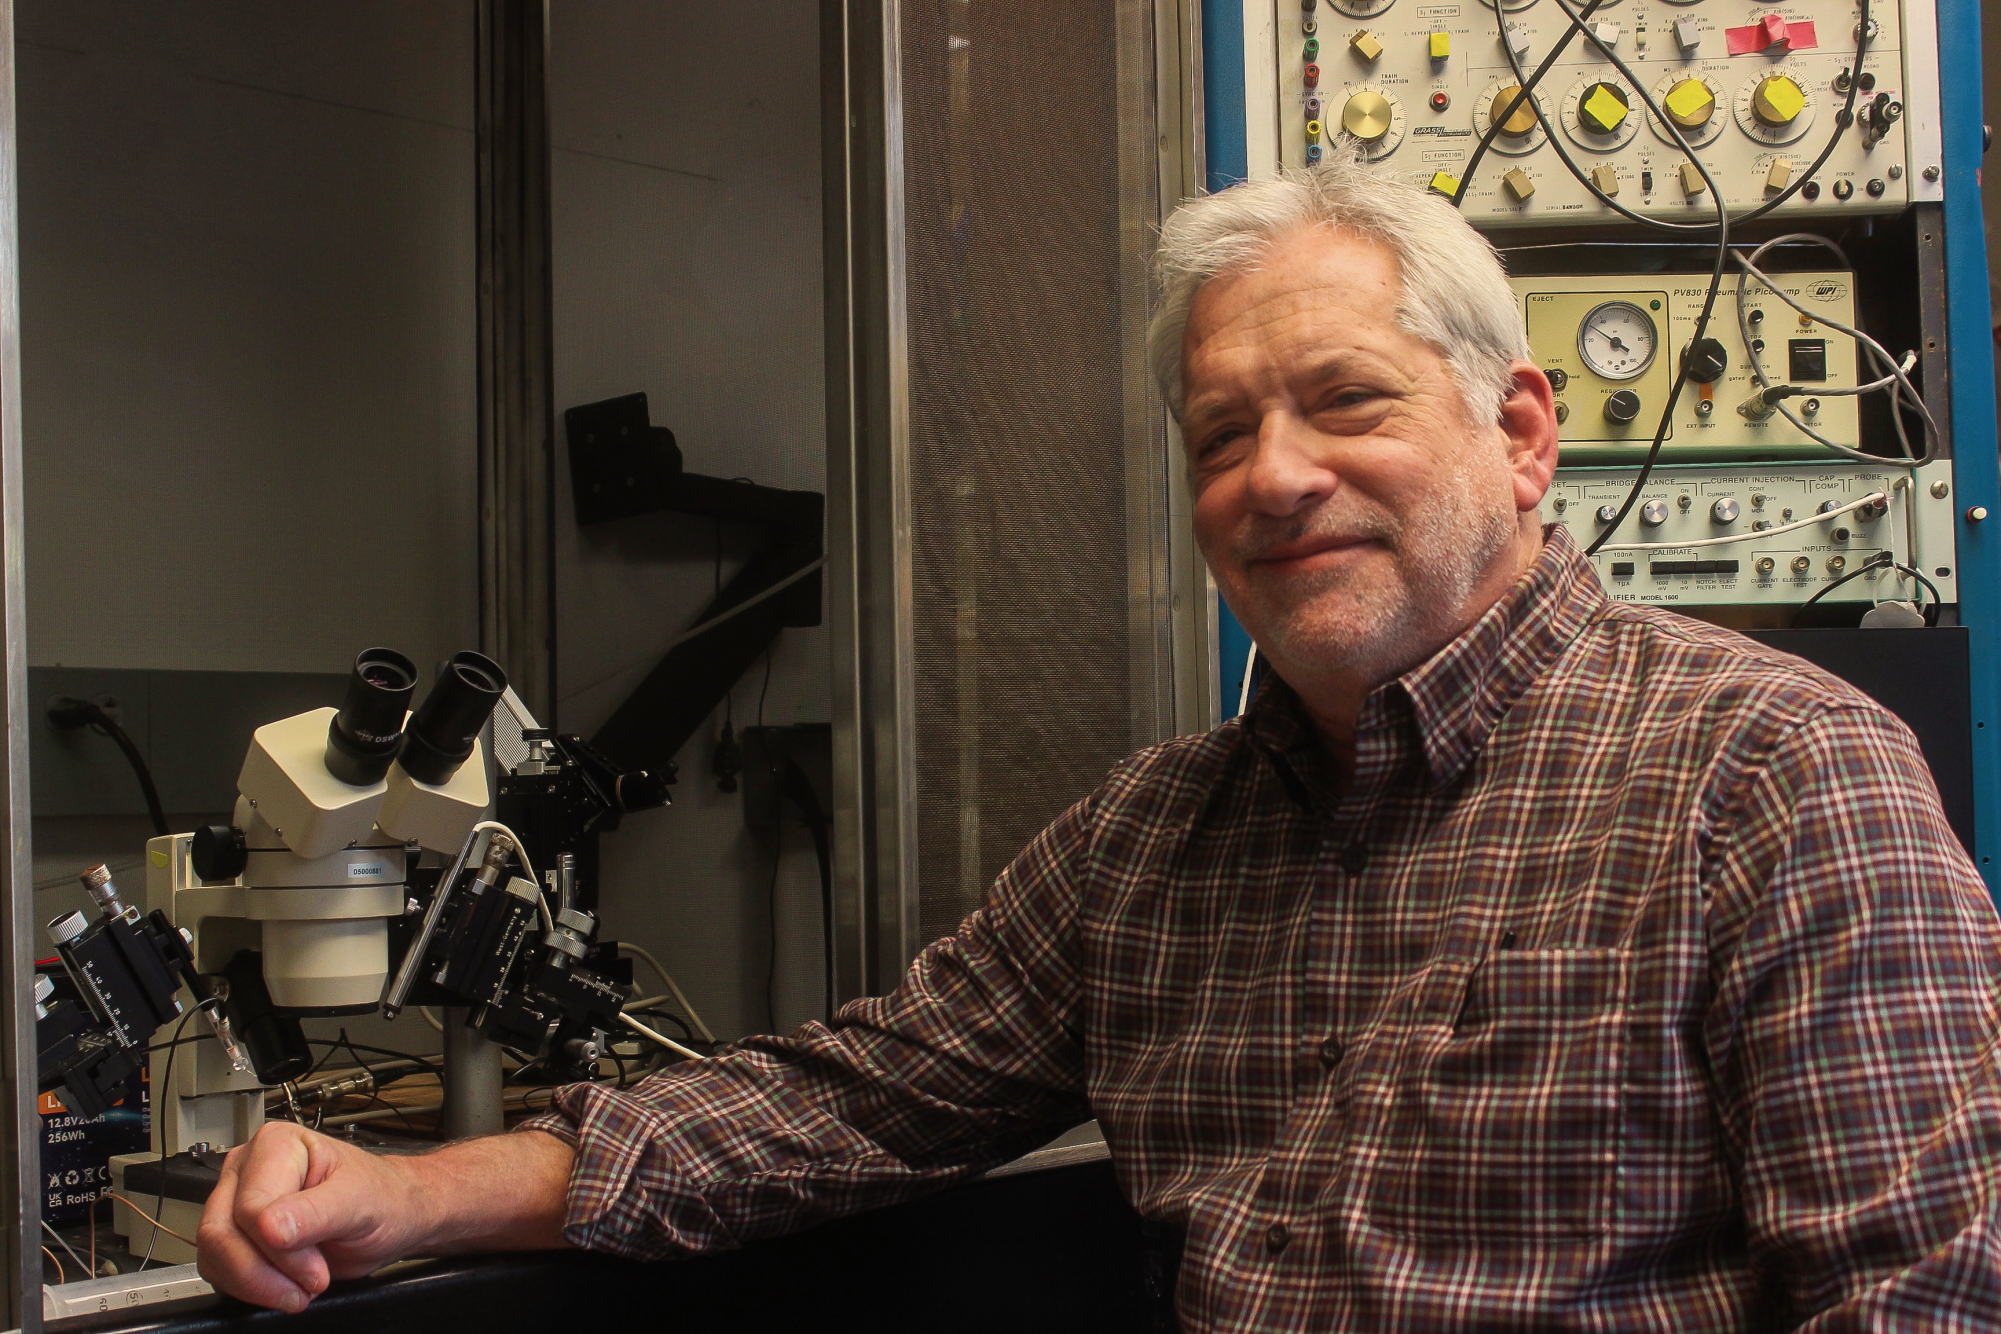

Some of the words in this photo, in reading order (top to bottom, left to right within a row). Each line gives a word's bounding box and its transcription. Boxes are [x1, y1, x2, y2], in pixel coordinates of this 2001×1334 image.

[1414, 127, 1443, 135] GRASS
[1673, 289, 1701, 297] PV830
[1815, 286, 1838, 296] WPI
[48, 1129, 86, 1144] 256Wh
[48, 1192, 62, 1200] UK
[66, 1191, 96, 1205] RoHS
[49, 1200, 62, 1208] CA
